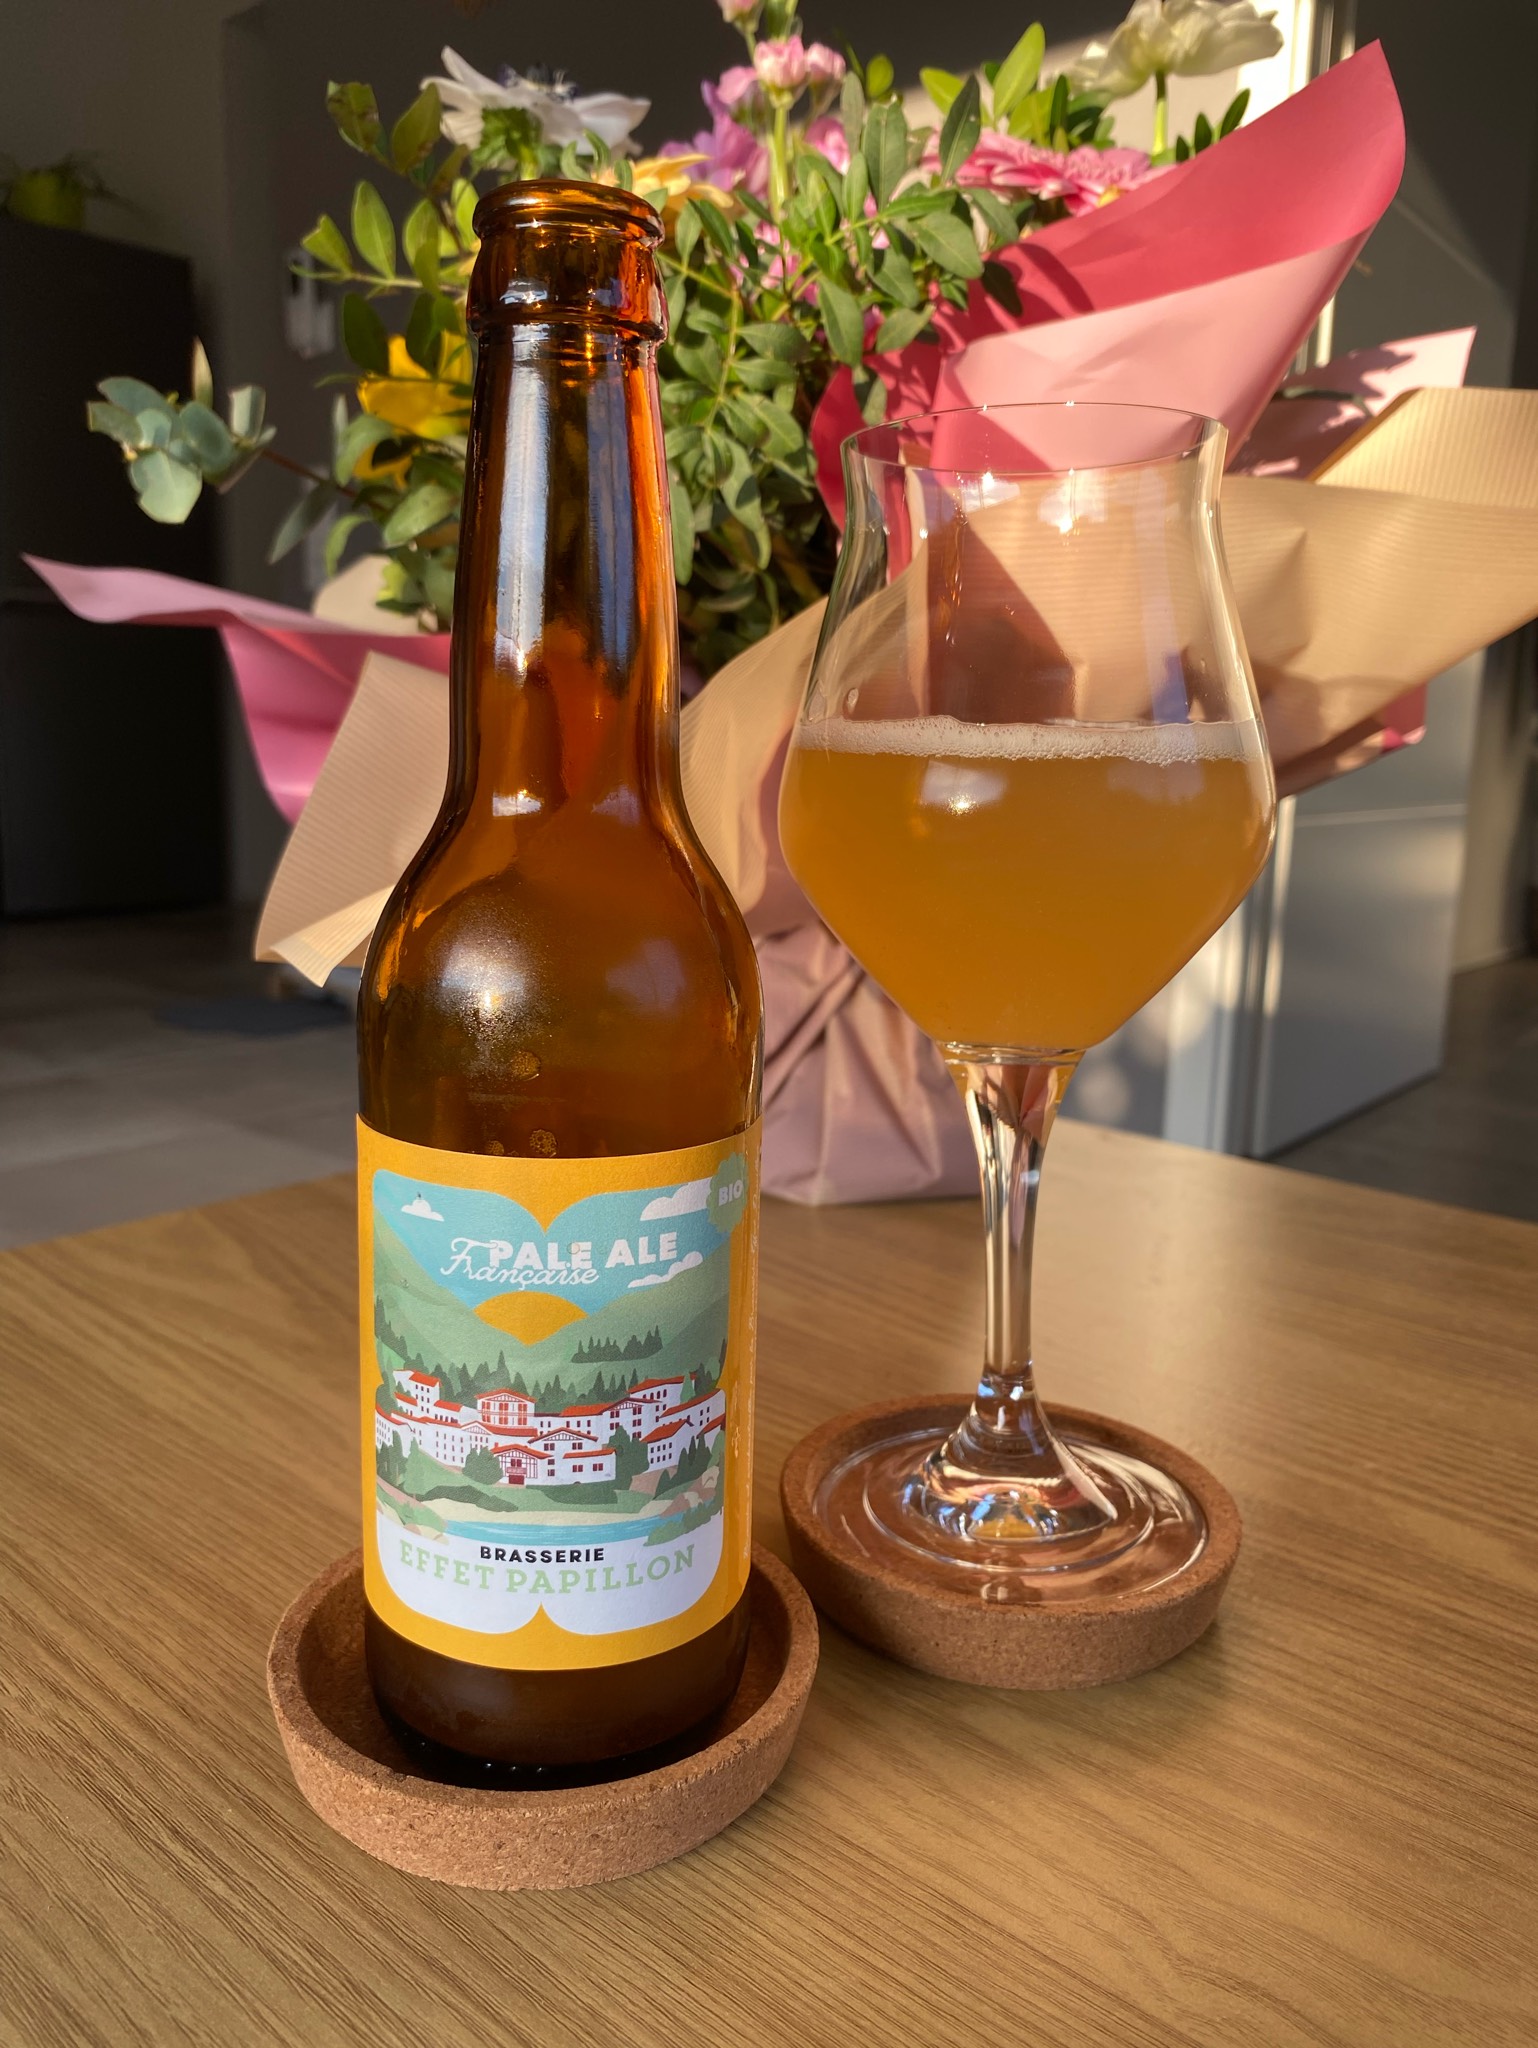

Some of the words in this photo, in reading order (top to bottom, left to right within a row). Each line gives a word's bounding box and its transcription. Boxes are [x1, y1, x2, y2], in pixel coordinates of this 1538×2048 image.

[718, 1179, 744, 1207] BIO
[440, 1237, 599, 1291] Française
[489, 1241, 593, 1271] PALE
[605, 1231, 678, 1269] ALE
[400, 1539, 495, 1591] EFFET
[506, 1544, 696, 1594] PAPILLON
[480, 1546, 605, 1563] BRASSERIE
